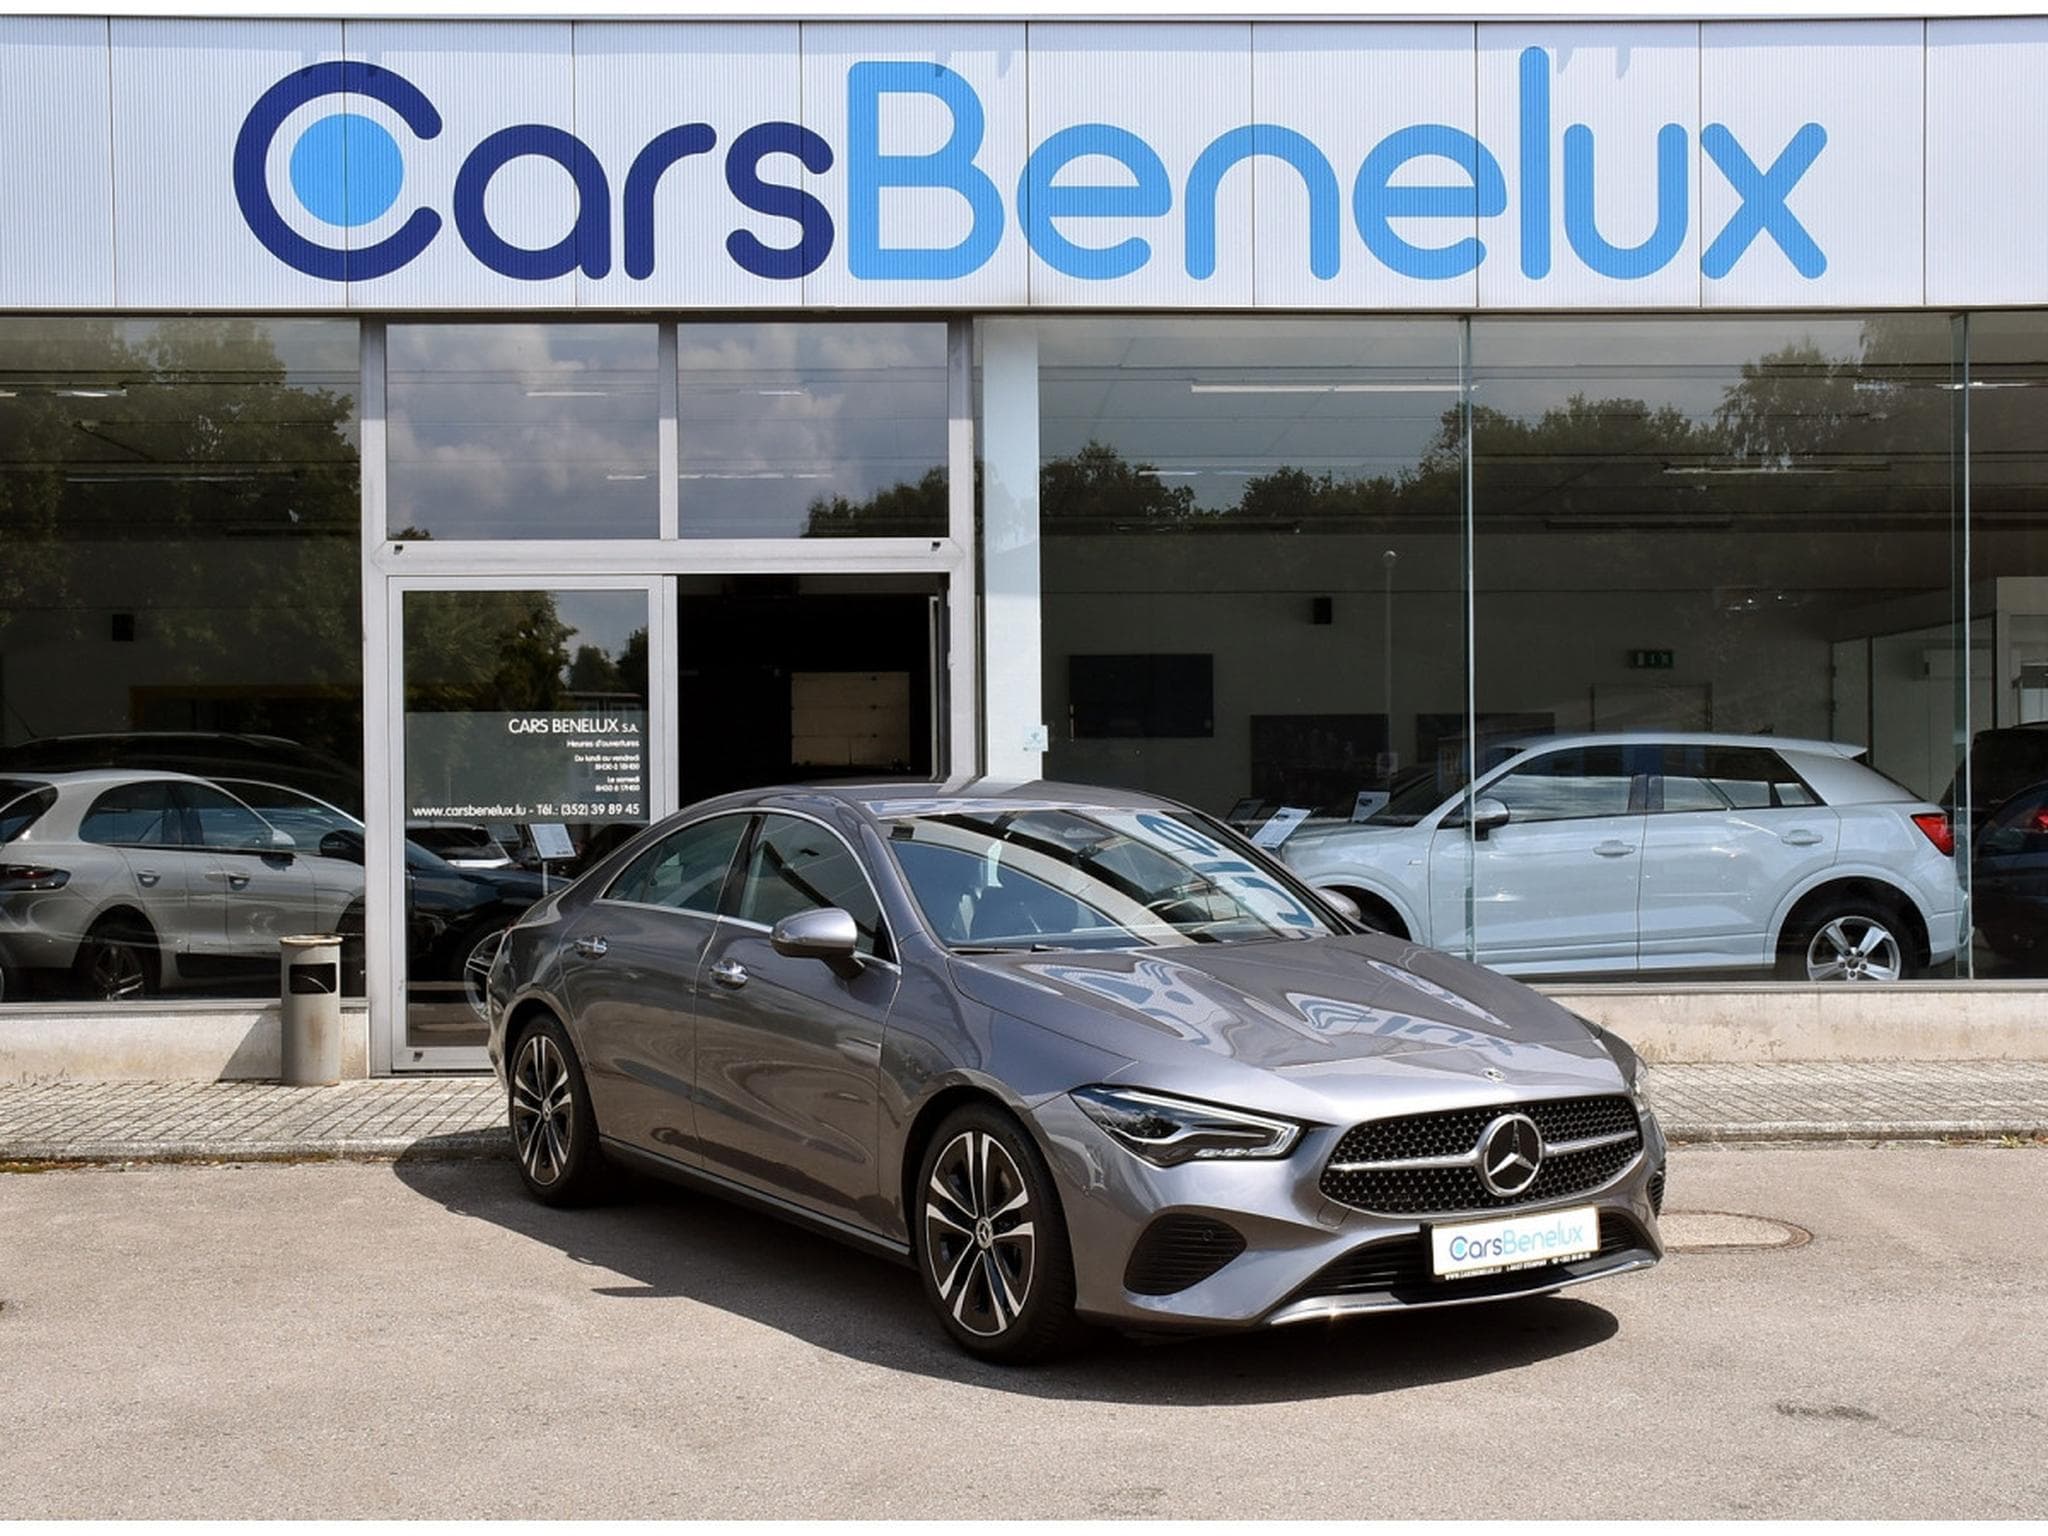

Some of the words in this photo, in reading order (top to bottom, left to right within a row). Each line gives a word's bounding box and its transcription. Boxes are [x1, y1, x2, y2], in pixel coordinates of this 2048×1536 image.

[232, 47, 1828, 281] CarsBenelux
[508, 718, 549, 733] CARS
[552, 718, 619, 733] BENELUX
[412, 804, 527, 816] www.carsbenelux.lu
[561, 803, 588, 816] (352)
[590, 803, 606, 815] 39
[608, 803, 623, 815] 89
[624, 803, 640, 815] 45
[1449, 1220, 1583, 1261] CarsBenelux
